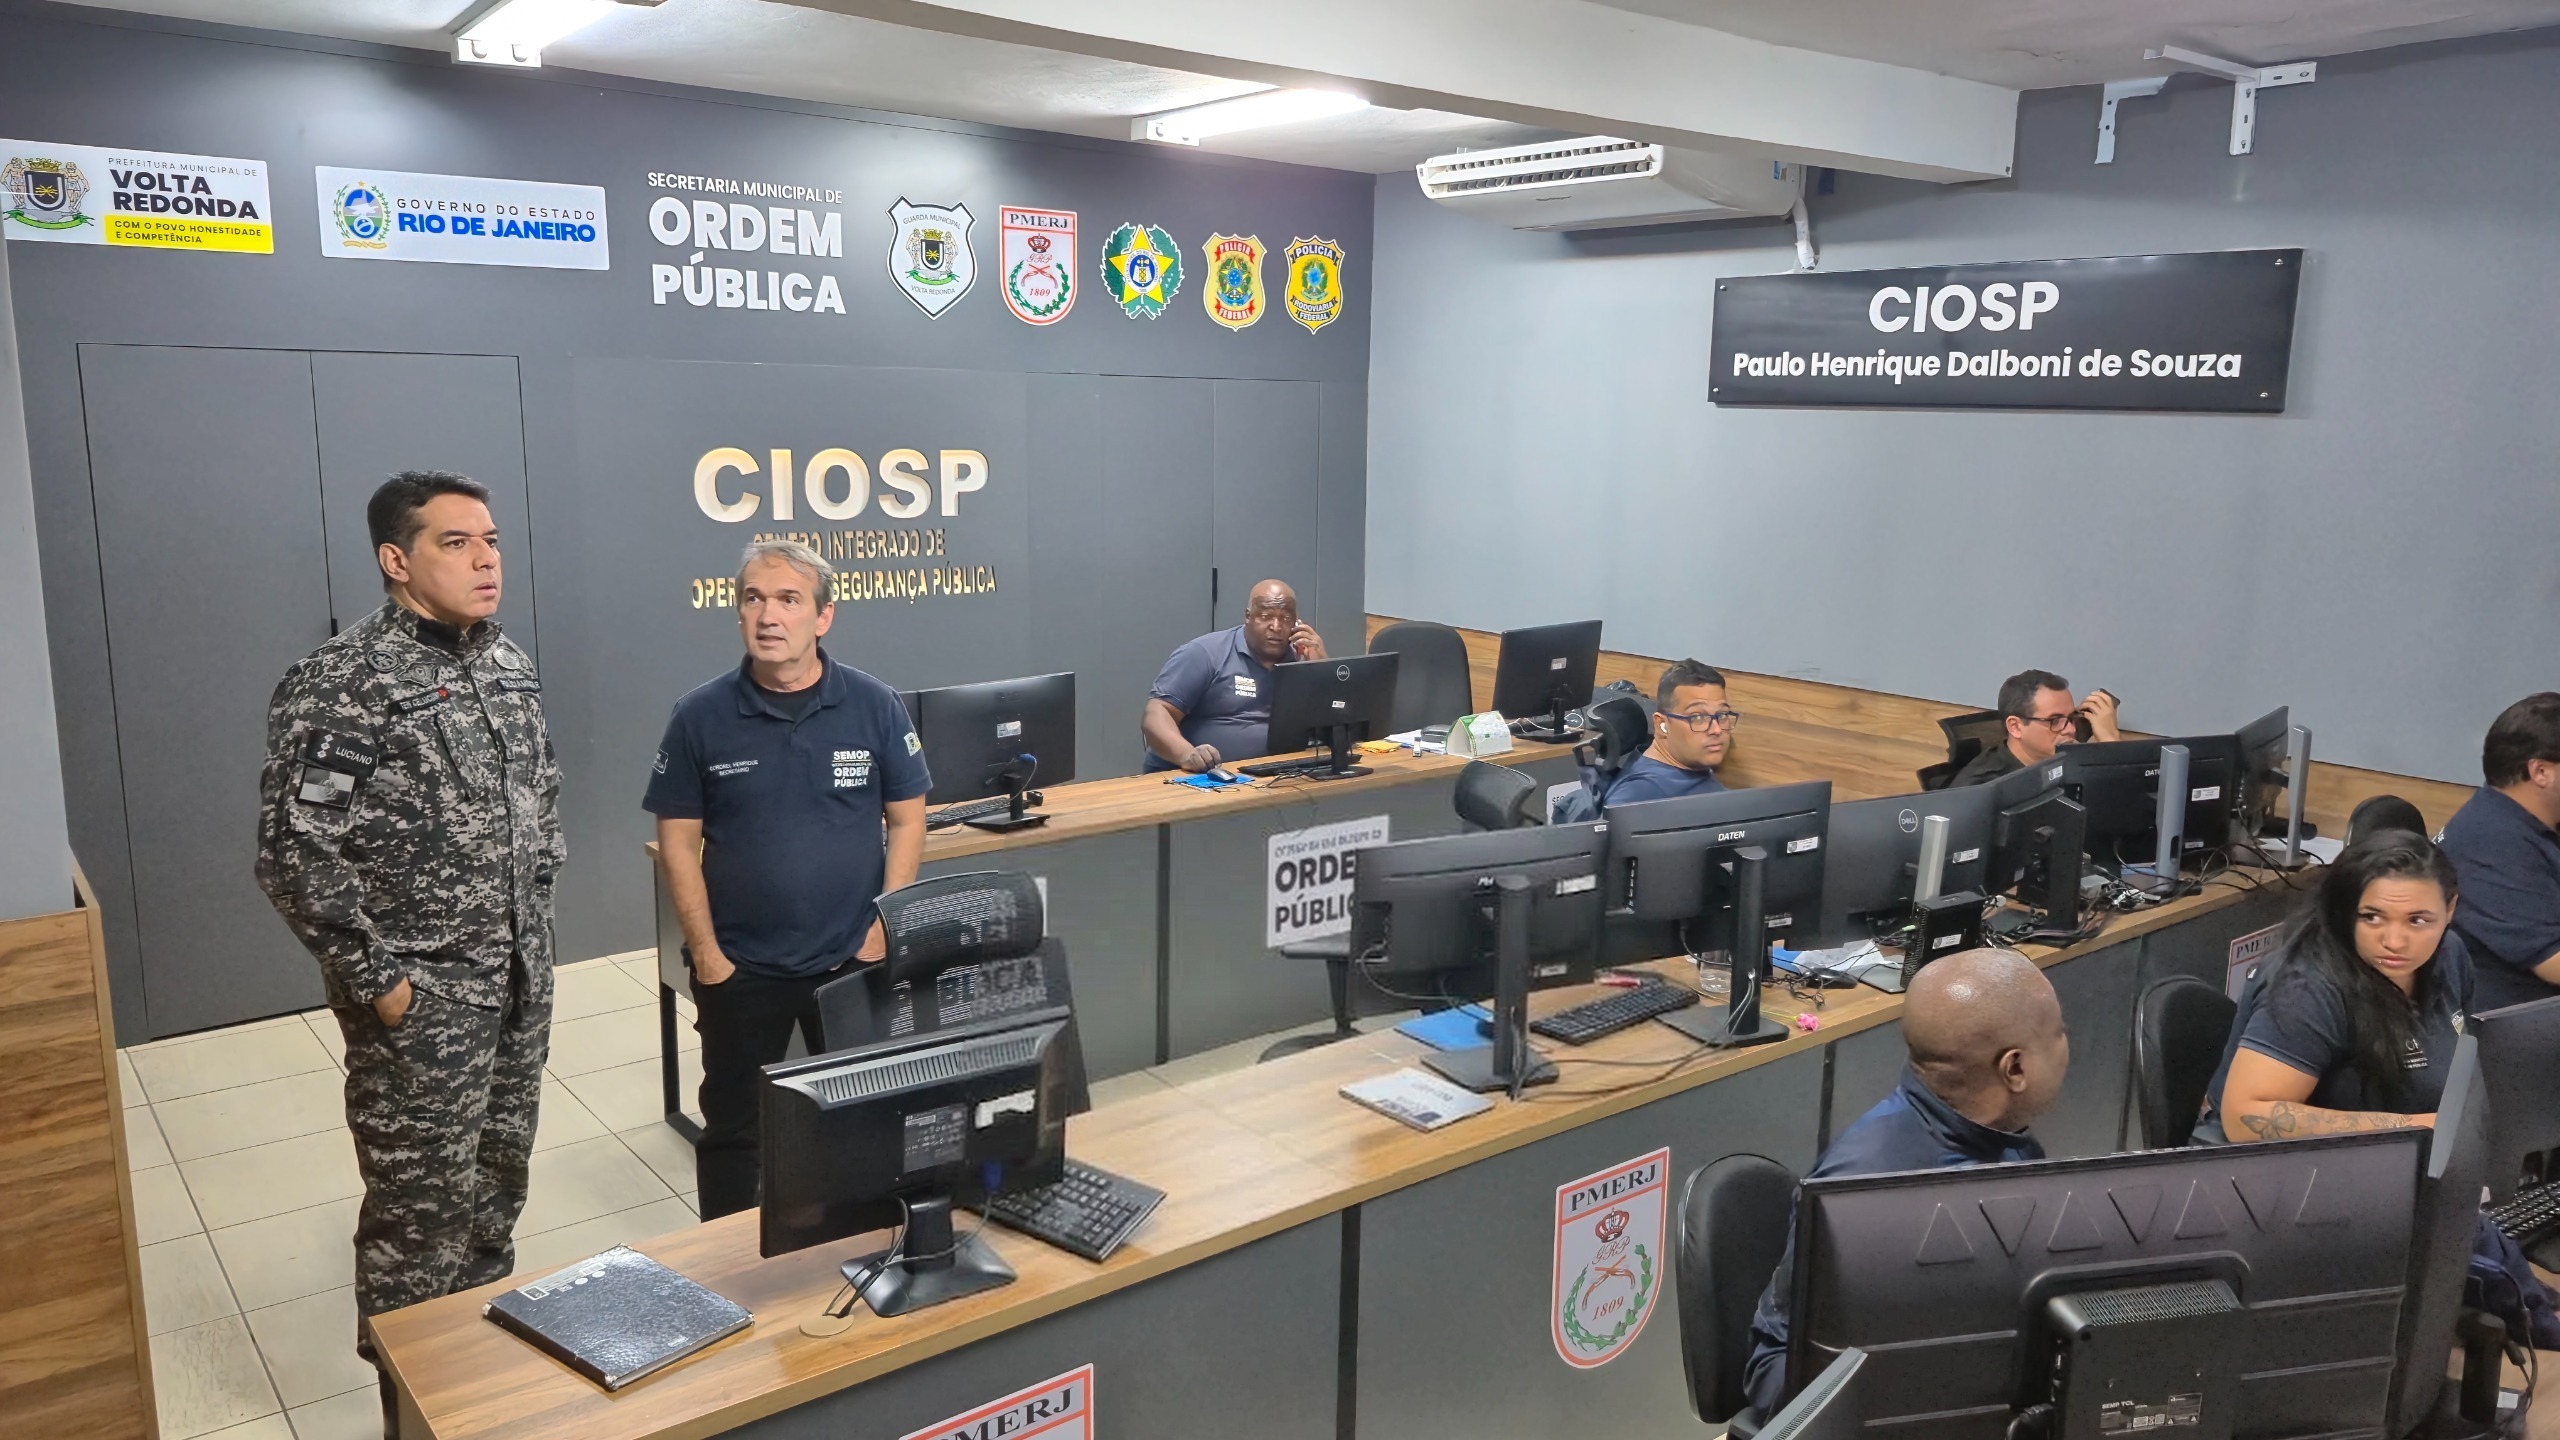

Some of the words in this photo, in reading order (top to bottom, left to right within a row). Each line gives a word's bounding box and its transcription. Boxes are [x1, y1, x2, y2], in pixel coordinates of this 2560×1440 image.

[108, 157, 176, 170] PREFEITURA
[180, 163, 241, 176] MUNICIPAL
[244, 168, 257, 176] DE
[110, 169, 212, 195] VOLTA
[647, 172, 741, 195] SECRETARIA
[743, 181, 822, 202] MUNICIPAL
[825, 189, 842, 204] DE
[113, 191, 259, 220] REDONDA
[397, 198, 486, 214] GOVERNO
[496, 204, 519, 216] DO
[529, 207, 595, 221] ESTADO
[115, 220, 140, 229] COM
[144, 222, 152, 230] O
[156, 223, 186, 232] POVO
[190, 225, 261, 236] HONESTIDADE
[398, 213, 446, 234] RIO
[451, 216, 486, 236] DE
[491, 218, 596, 242] JANEIRO
[649, 196, 843, 258] ORDEM
[902, 214, 929, 224] GUARDA
[930, 214, 961, 230] MUNICIPAL
[1009, 213, 1068, 229] PMERJ
[125, 232, 202, 243] COMPETÊNCIA
[652, 251, 847, 314] PÚBLICA
[911, 285, 928, 294] VOLTA
[929, 288, 956, 296] REDONDA
[1029, 288, 1051, 296] 1809
[1299, 312, 1328, 320] FEDERAL
[1868, 281, 2060, 333] CIOSP
[1733, 351, 1806, 377] Paulo
[1810, 348, 1941, 385] Henrique
[1947, 346, 2072, 378] Dalboni
[2078, 348, 2123, 378] de
[2129, 349, 2242, 378] Souza
[693, 447, 990, 523] CIOSP
[828, 529, 921, 560] INTEGRADO
[926, 528, 946, 556] DE
[832, 568, 928, 605] SEGURANÇA
[933, 560, 997, 596] PÚBLICA
[335, 746, 373, 765] LUCIANO
[833, 750, 870, 760] SEMOP
[834, 766, 870, 777] ORDEM
[834, 776, 868, 788] PÚBLICA
[1901, 816, 1916, 824] DELL
[1718, 830, 1746, 842] DATEN
[1275, 849, 1356, 893] ORDE
[1275, 893, 1354, 934] PÚBLI
[1570, 1163, 1656, 1212] PMERJ
[1592, 1296, 1625, 1321] 1809
[940, 1386, 1074, 1440] MERJ
[2102, 1401, 2120, 1410] SEMP
